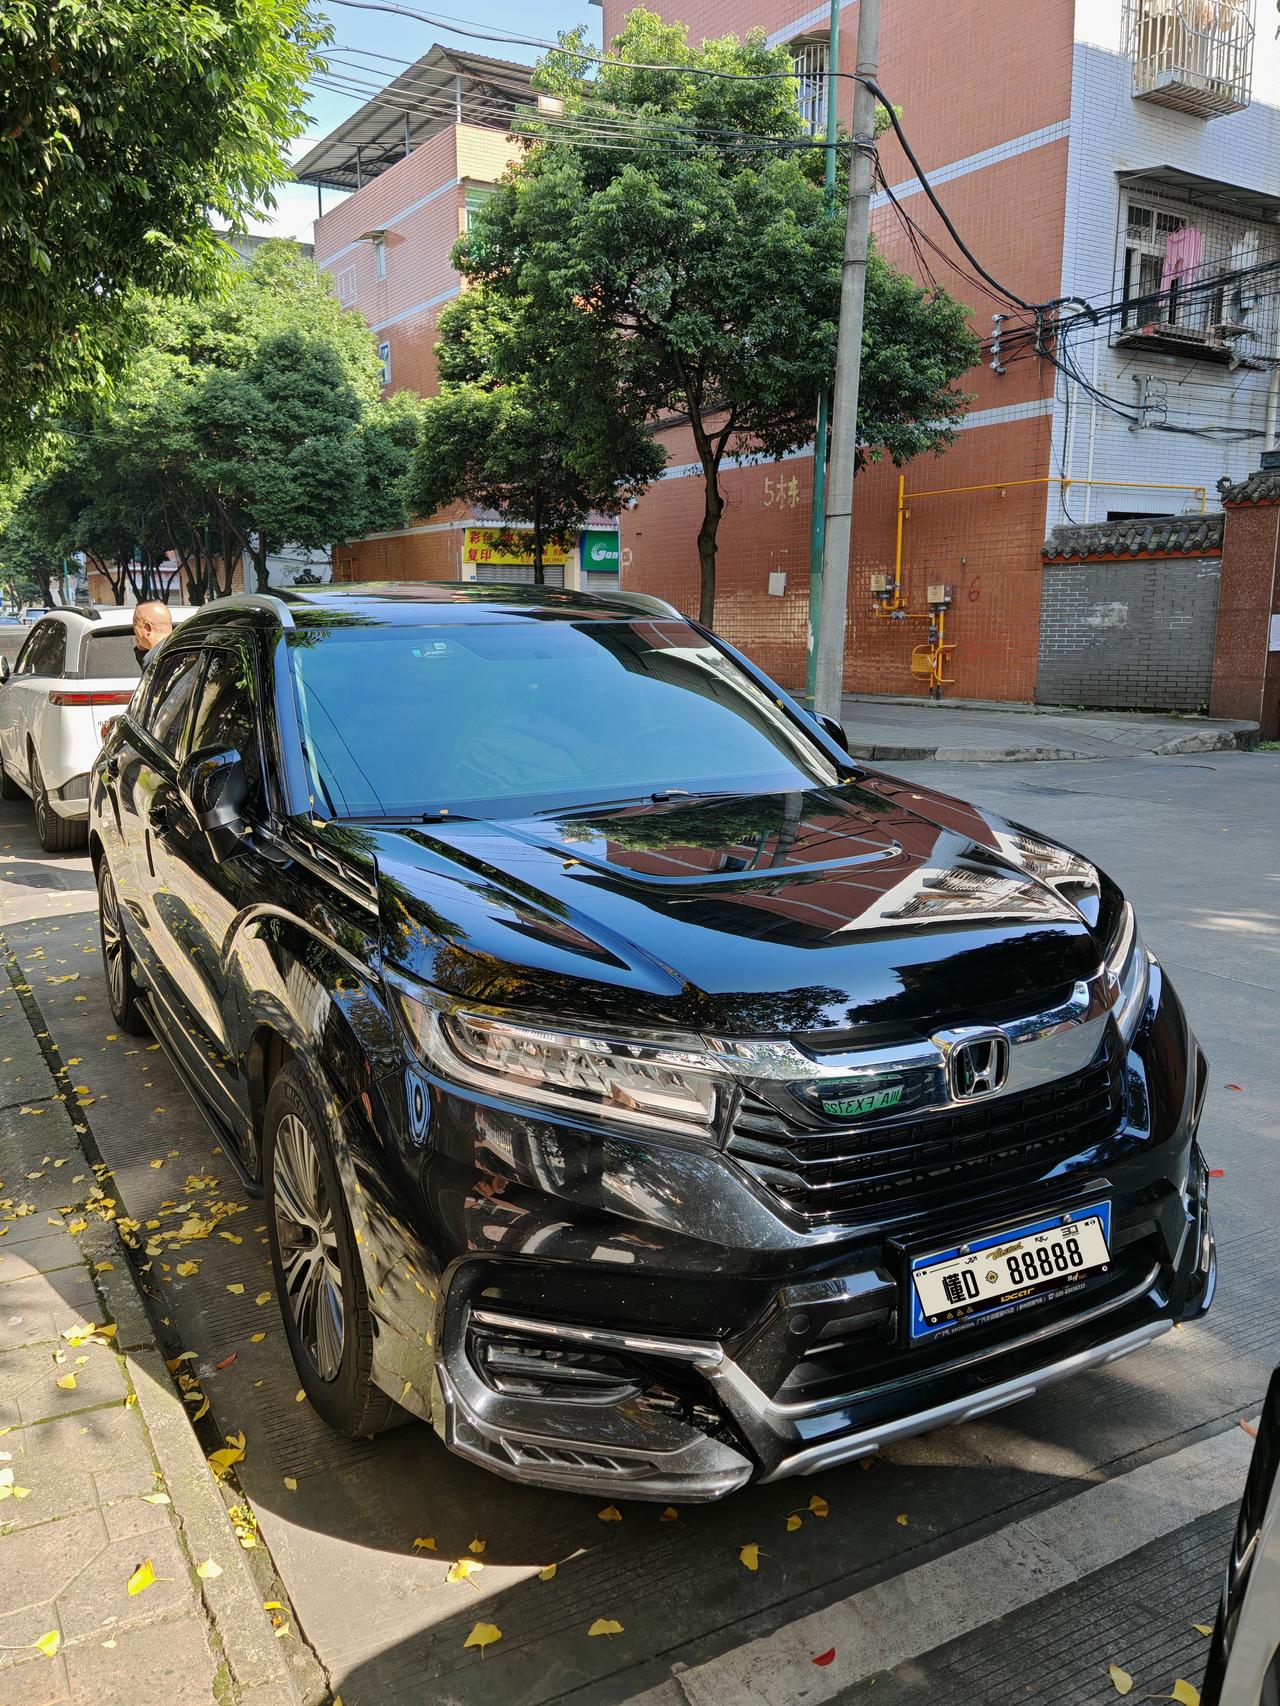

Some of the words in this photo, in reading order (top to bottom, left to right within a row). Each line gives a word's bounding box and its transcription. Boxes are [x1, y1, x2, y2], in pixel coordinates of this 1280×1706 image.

[763, 475, 800, 509] 5栋
[468, 548, 491, 561] 复印
[968, 576, 980, 602] 6
[1006, 1238, 1084, 1286] 88888
[951, 1321, 975, 1333] HONDA
